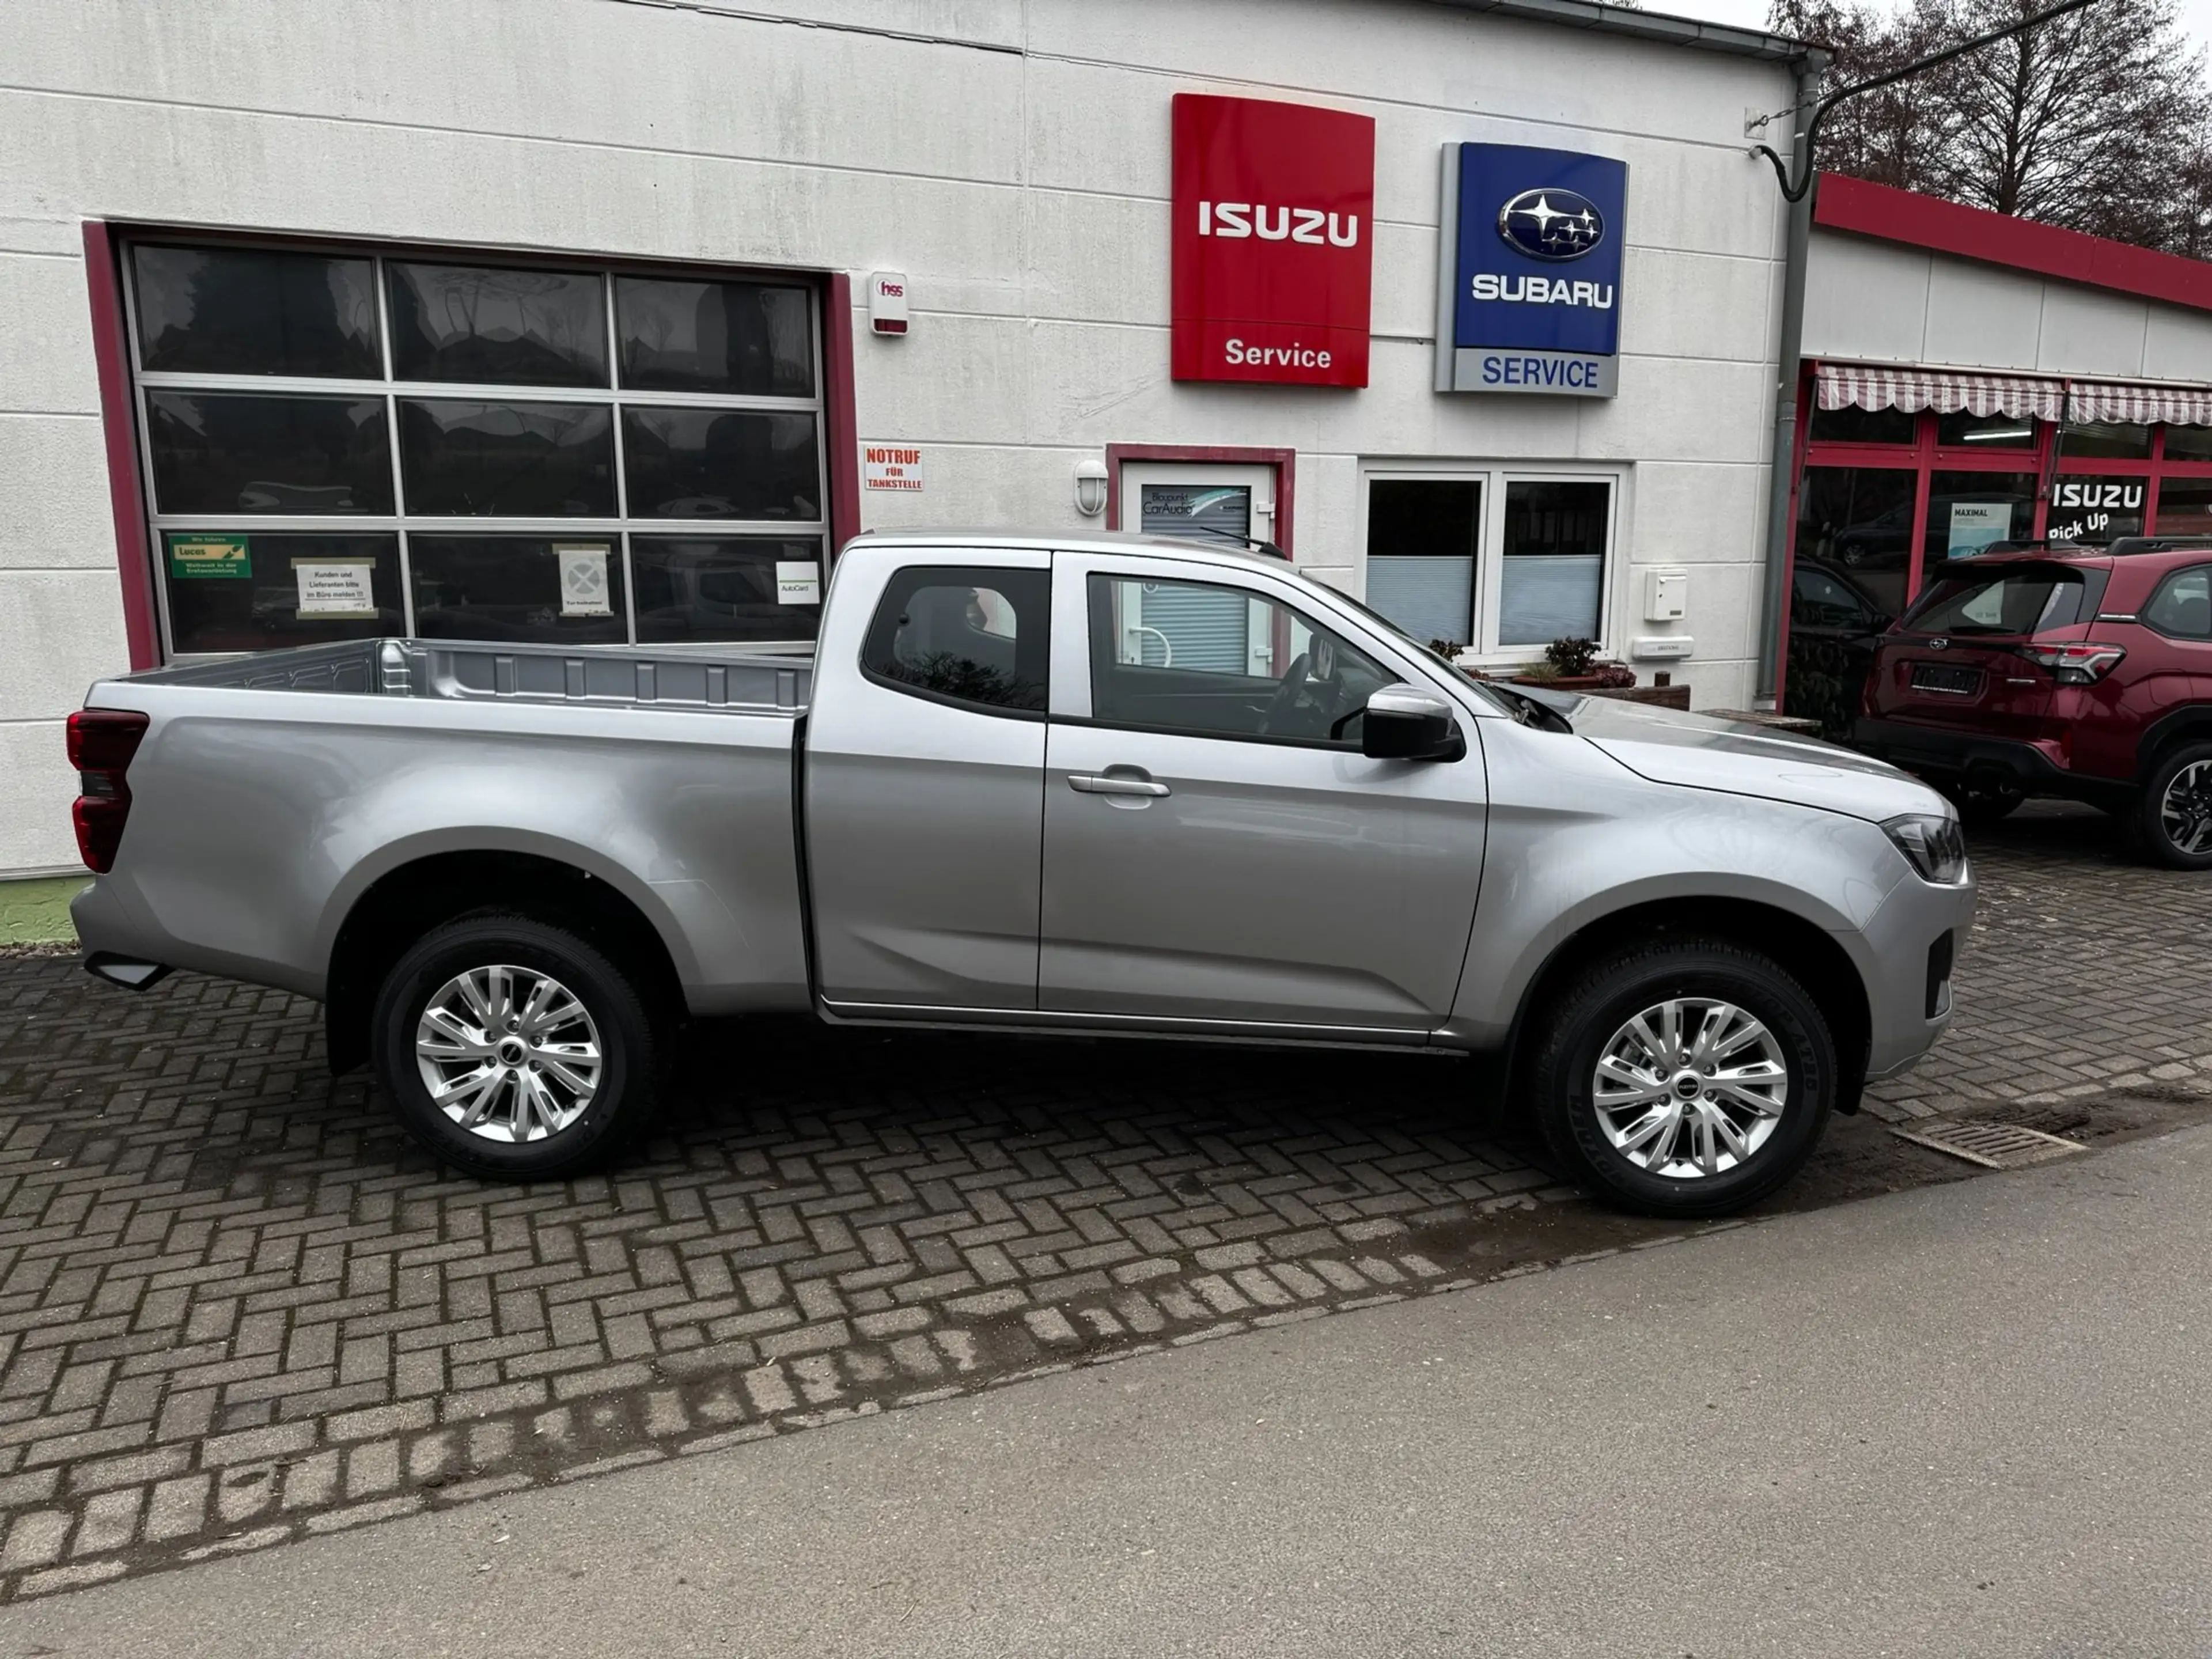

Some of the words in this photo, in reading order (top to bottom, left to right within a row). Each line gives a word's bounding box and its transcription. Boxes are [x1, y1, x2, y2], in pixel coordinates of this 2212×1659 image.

[1199, 201, 1358, 248] ISUZU
[881, 281, 903, 297] hss
[1472, 274, 1613, 309] SUBARU
[1225, 338, 1332, 369] Service
[1482, 356, 1599, 389] SERVICE
[866, 448, 921, 465] NOTRUF
[885, 467, 903, 476] FÜR
[868, 479, 922, 489] TANKSTELLE
[1152, 492, 1188, 502] Blaupunkt
[2052, 483, 2143, 508] ISUZU
[1142, 502, 1194, 515] CarAudio
[1955, 509, 1988, 517] MAXIMAL
[2048, 519, 2084, 540] Pick
[2086, 512, 2109, 531] Up
[179, 546, 206, 555] Lucas
